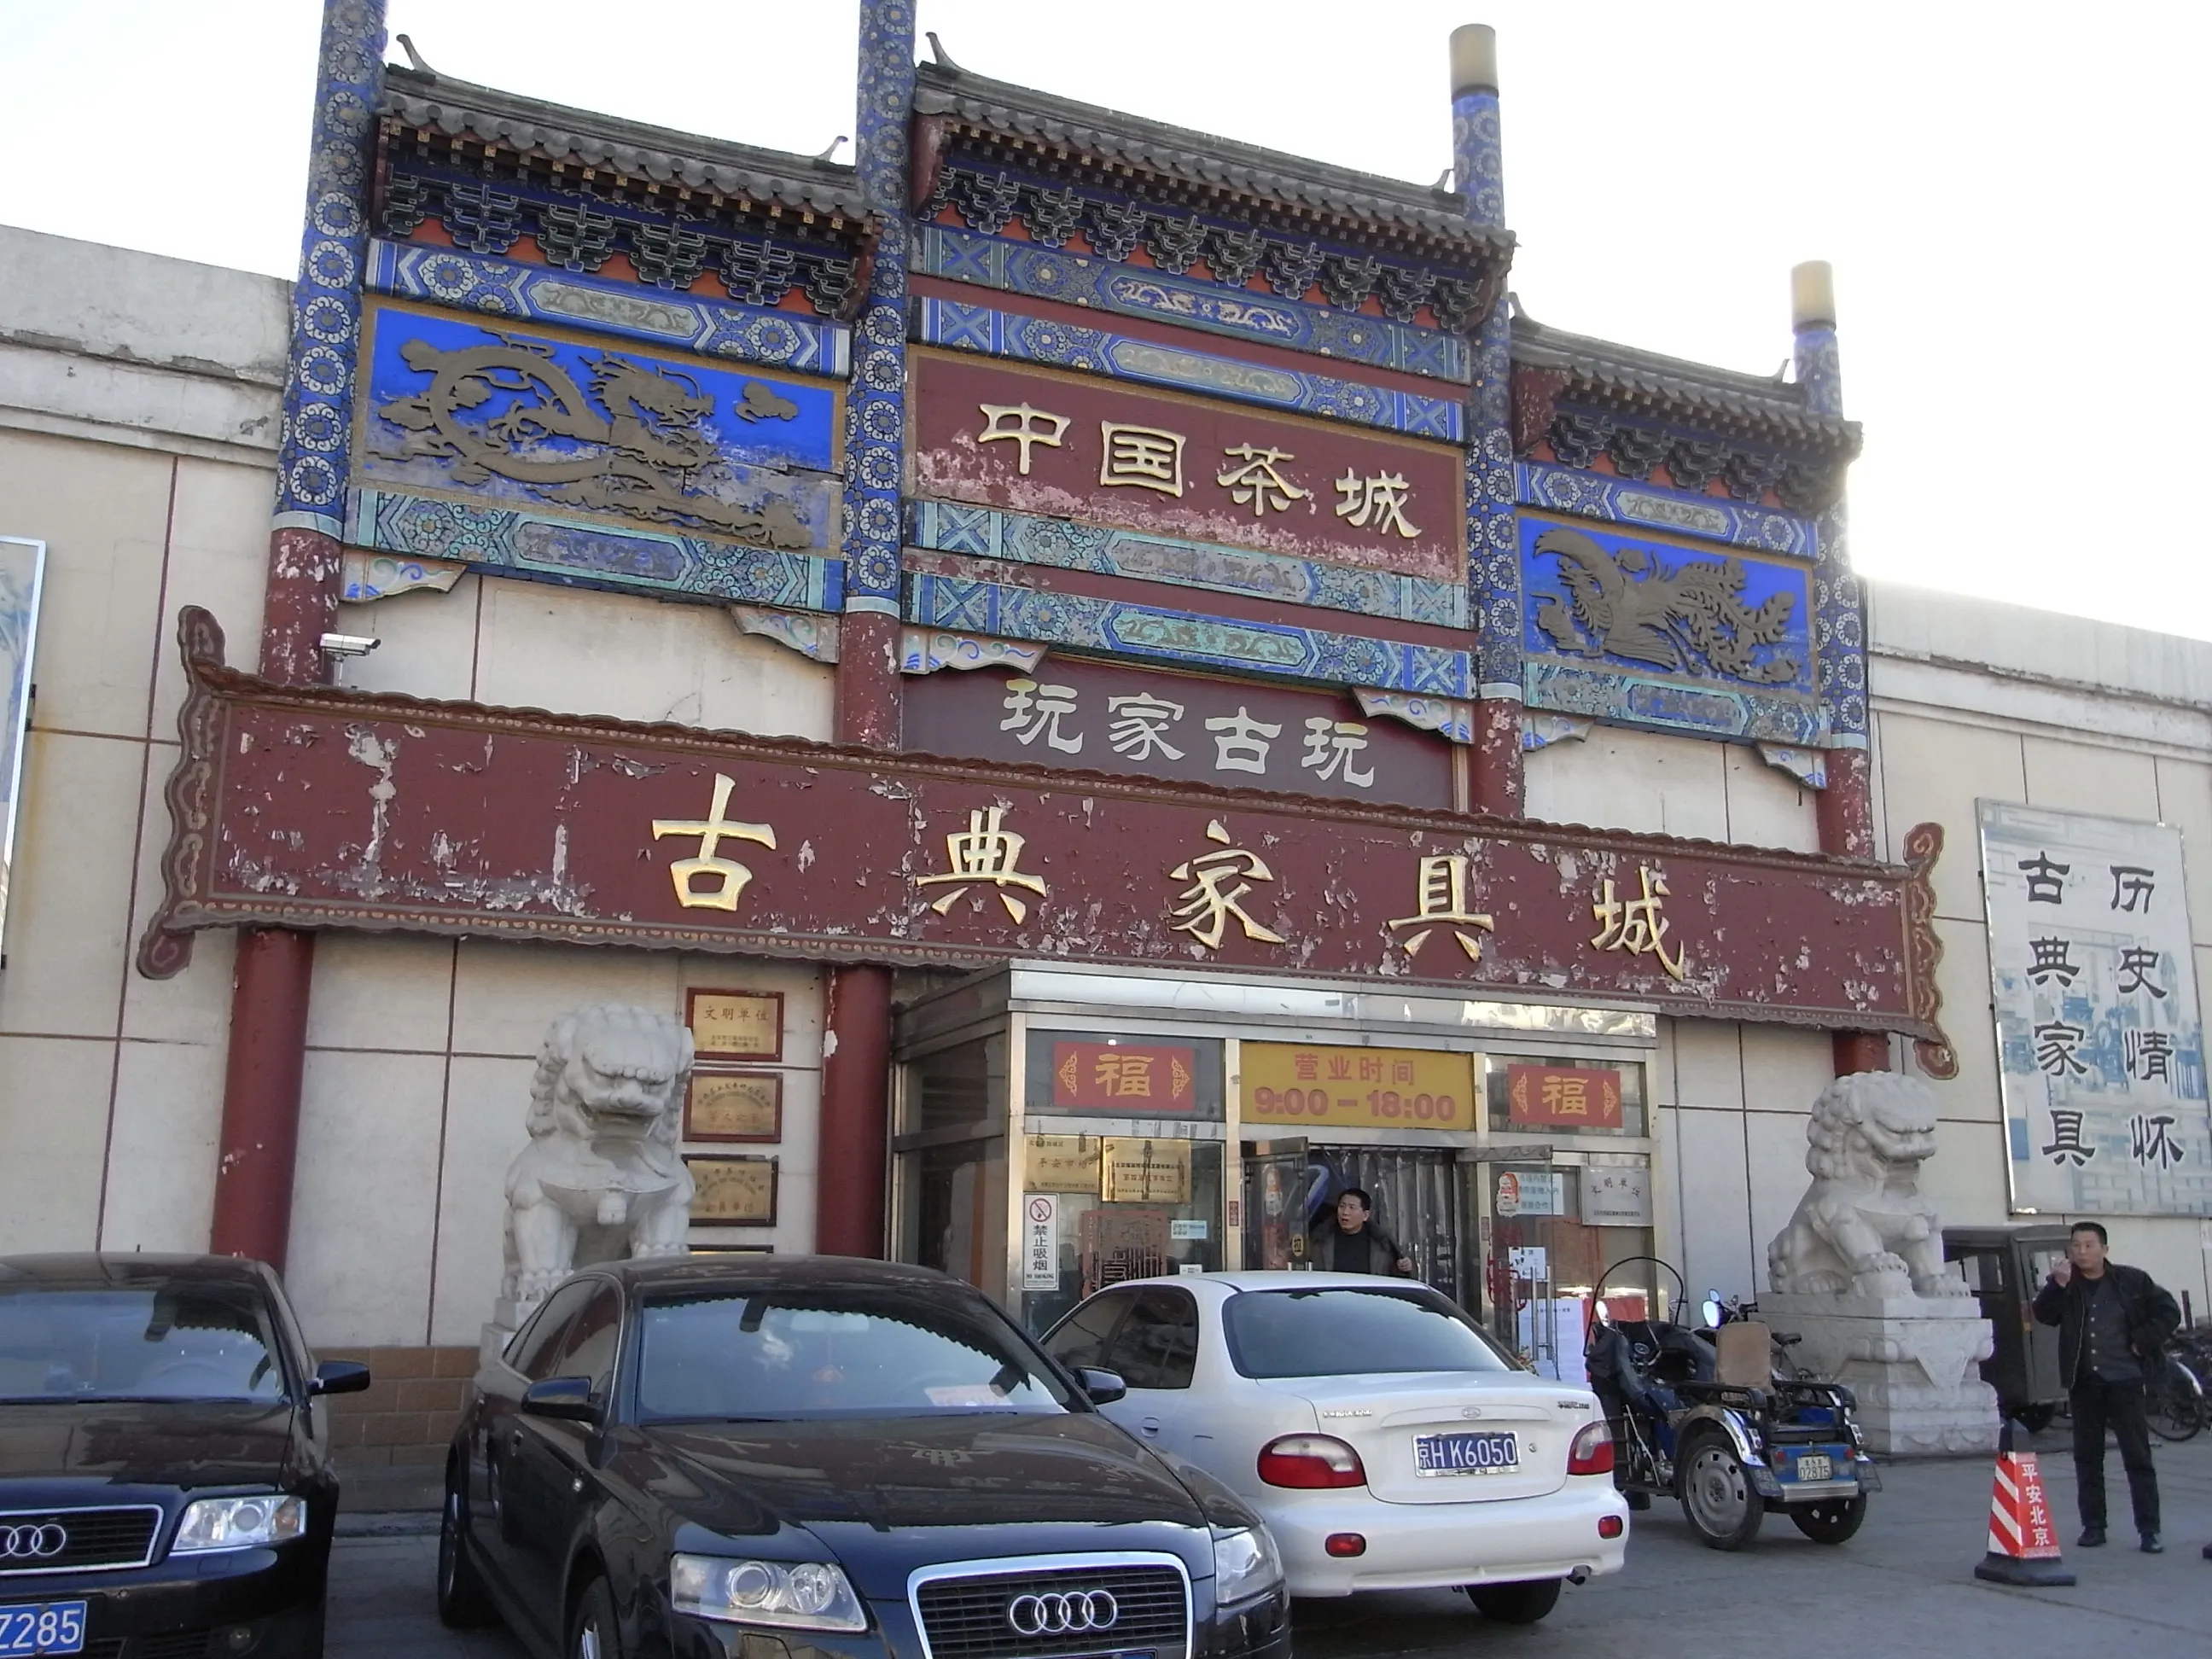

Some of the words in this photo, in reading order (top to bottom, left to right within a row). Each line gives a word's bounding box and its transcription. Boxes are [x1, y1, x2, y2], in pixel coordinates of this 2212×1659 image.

[978, 402, 1423, 539] 中国茶城
[1000, 678, 1375, 788] 玩家古玩
[651, 773, 1685, 982] 古典家具城
[2017, 850, 2095, 1167] 古典家具
[2109, 864, 2185, 1170] 历史情怀
[1095, 1052, 1155, 1097] 福
[1295, 1052, 1415, 1086] 营业时间
[1541, 1074, 1589, 1115] 福
[1033, 1225, 1049, 1271] 禁止吸烟
[2022, 1464, 2050, 1545] 平安北京
